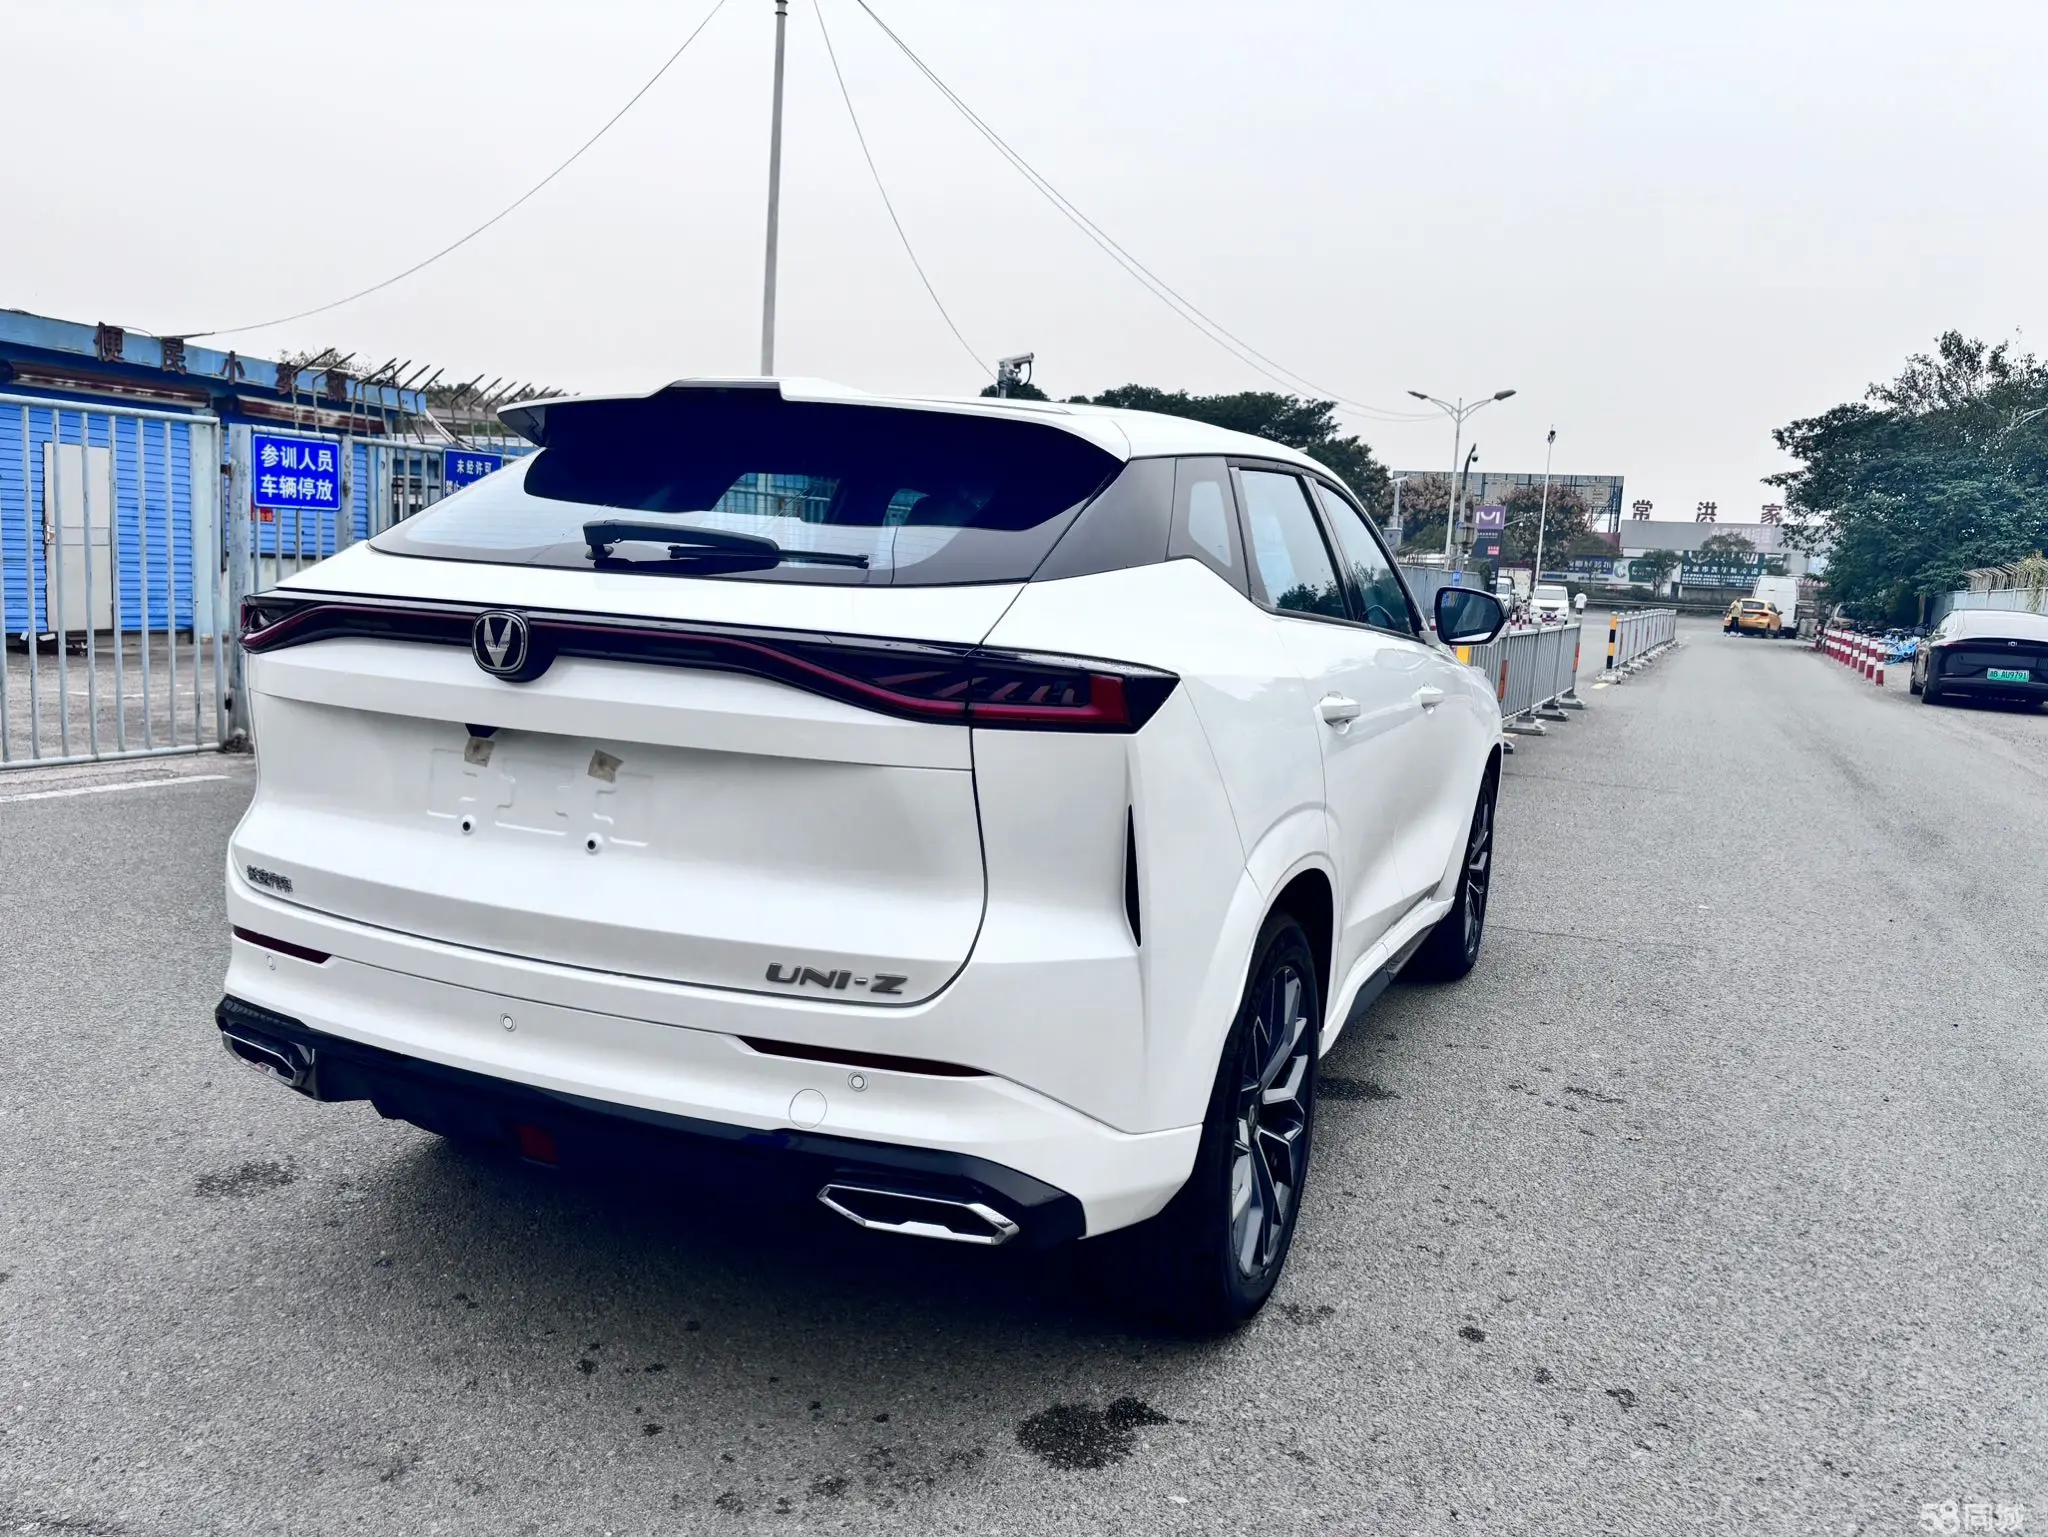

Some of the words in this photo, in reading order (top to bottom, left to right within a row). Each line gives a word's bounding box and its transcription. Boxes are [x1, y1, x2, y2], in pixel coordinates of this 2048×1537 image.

[260, 443, 334, 473] 参训人员
[456, 459, 492, 476] 未经许可
[260, 474, 334, 501] 车辆停放
[765, 962, 908, 995] UNI-Z
